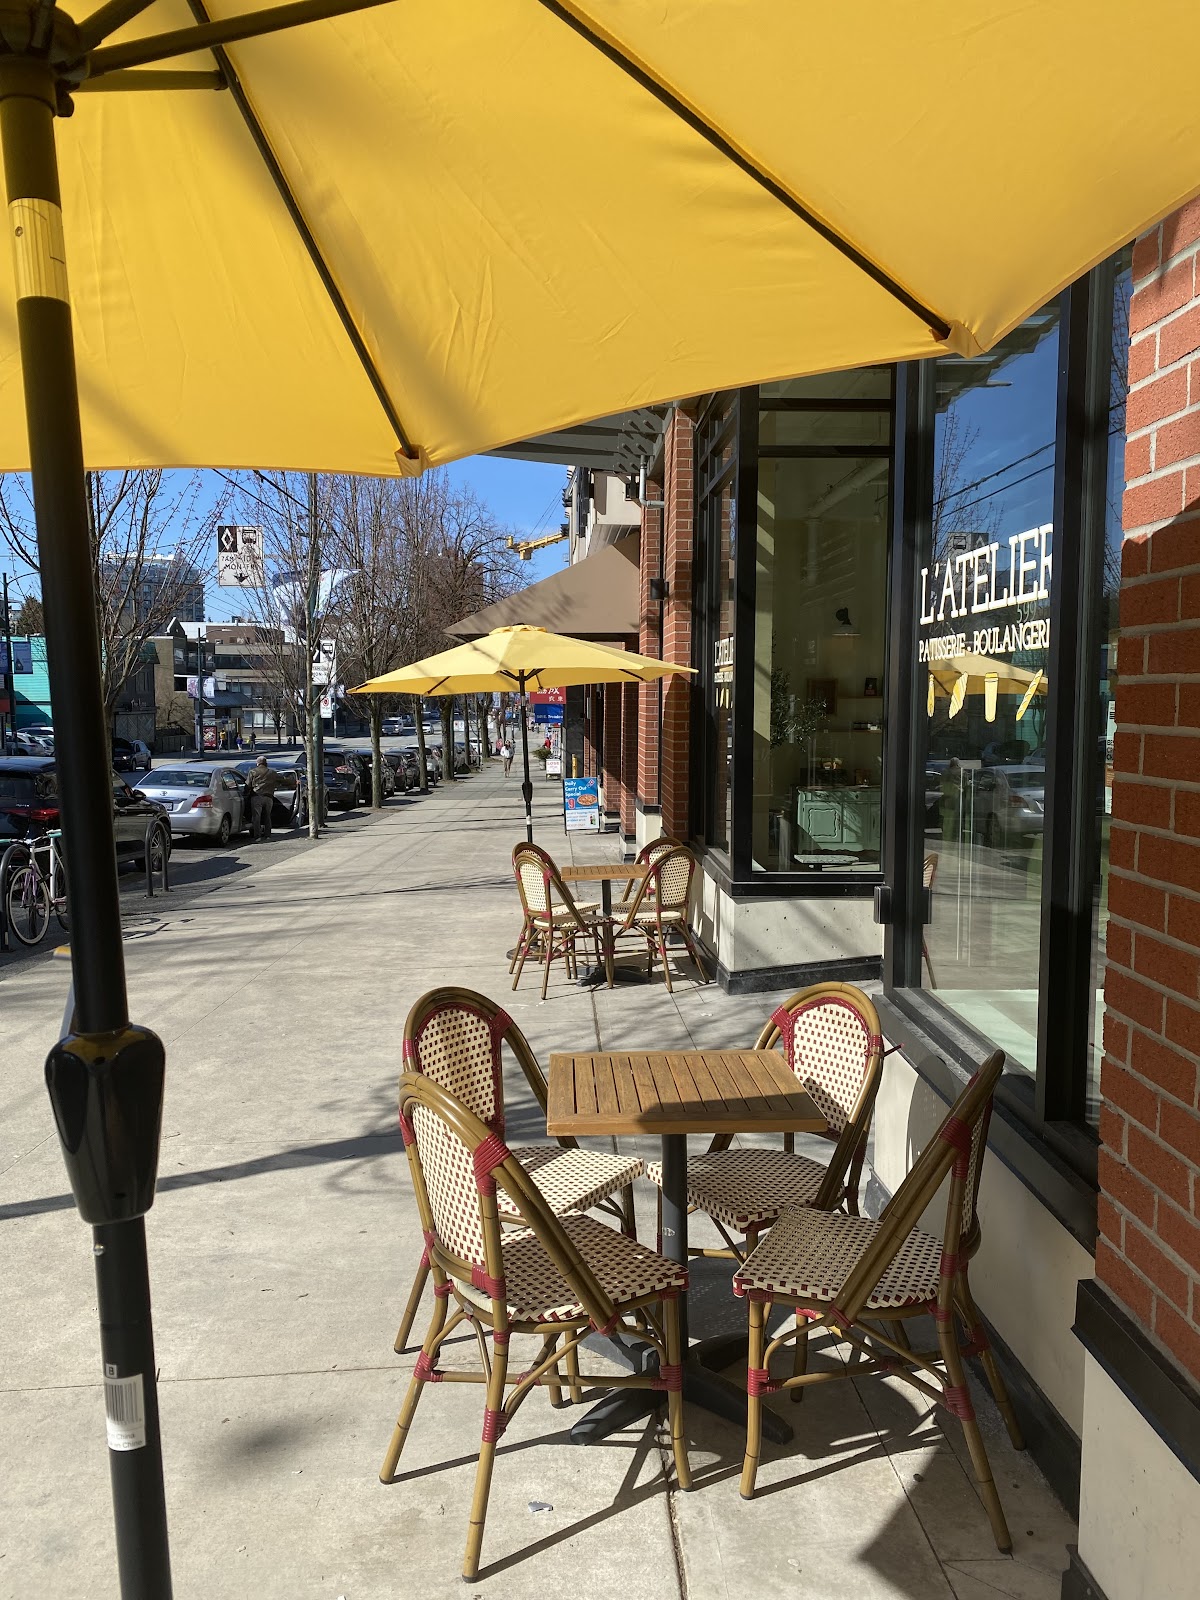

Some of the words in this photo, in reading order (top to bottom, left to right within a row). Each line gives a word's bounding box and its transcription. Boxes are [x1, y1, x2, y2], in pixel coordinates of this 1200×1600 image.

[920, 523, 1053, 625] L'ATELIER
[919, 633, 966, 662] PATISSERIE
[109, 1367, 114, 1375] B
